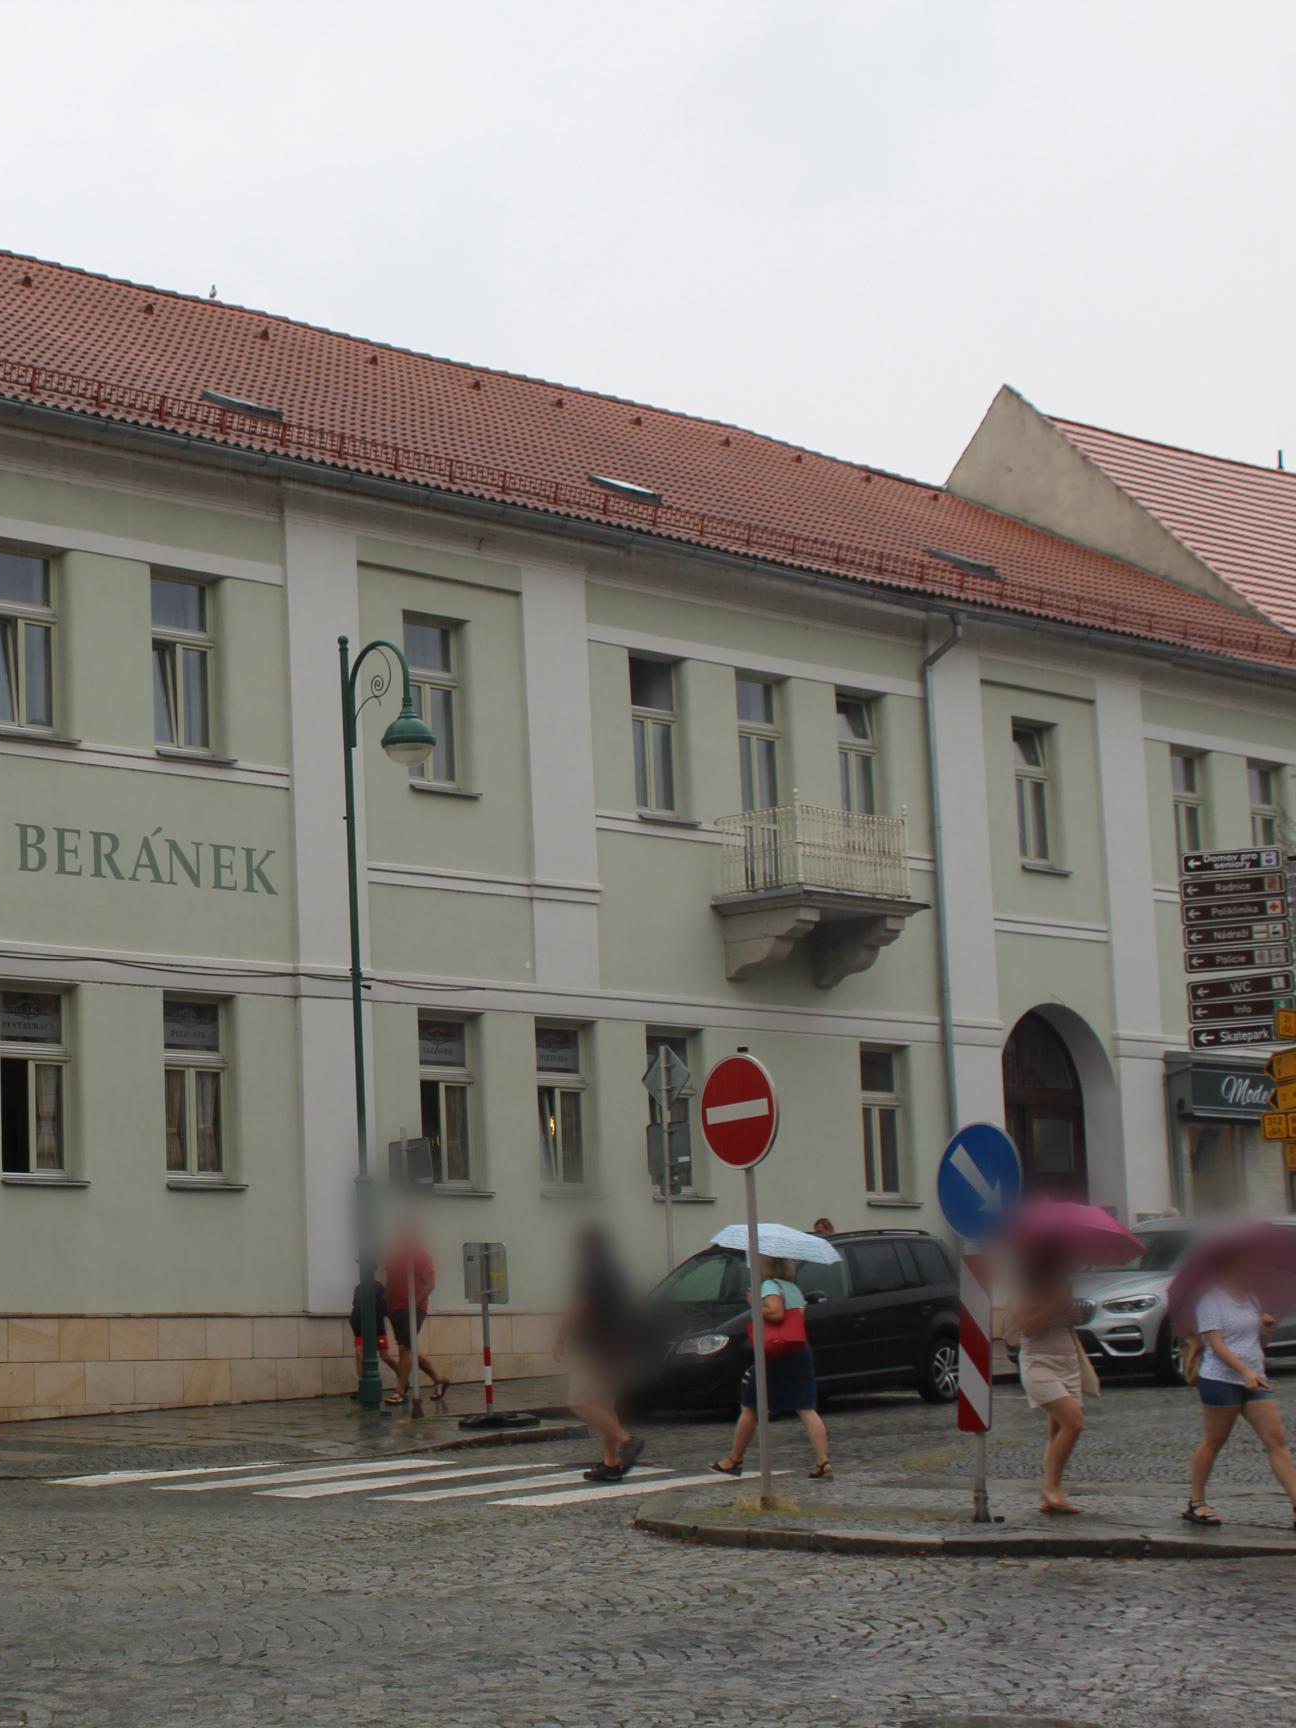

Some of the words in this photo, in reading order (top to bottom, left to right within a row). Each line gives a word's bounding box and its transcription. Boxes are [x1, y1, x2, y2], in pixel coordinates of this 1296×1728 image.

[15, 823, 279, 896] BERÁNEK
[1203, 853, 1238, 863] Domov
[1240, 852, 1258, 862] pro
[1214, 860, 1251, 870] seniory
[1215, 881, 1251, 892] Radnice
[1211, 904, 1259, 917] Poliklinika
[1214, 928, 1249, 940] Nádraží
[1216, 955, 1246, 965] Policie
[1229, 980, 1252, 994] WC
[1234, 1004, 1252, 1014] Info
[1219, 1028, 1270, 1042] Skatepark
